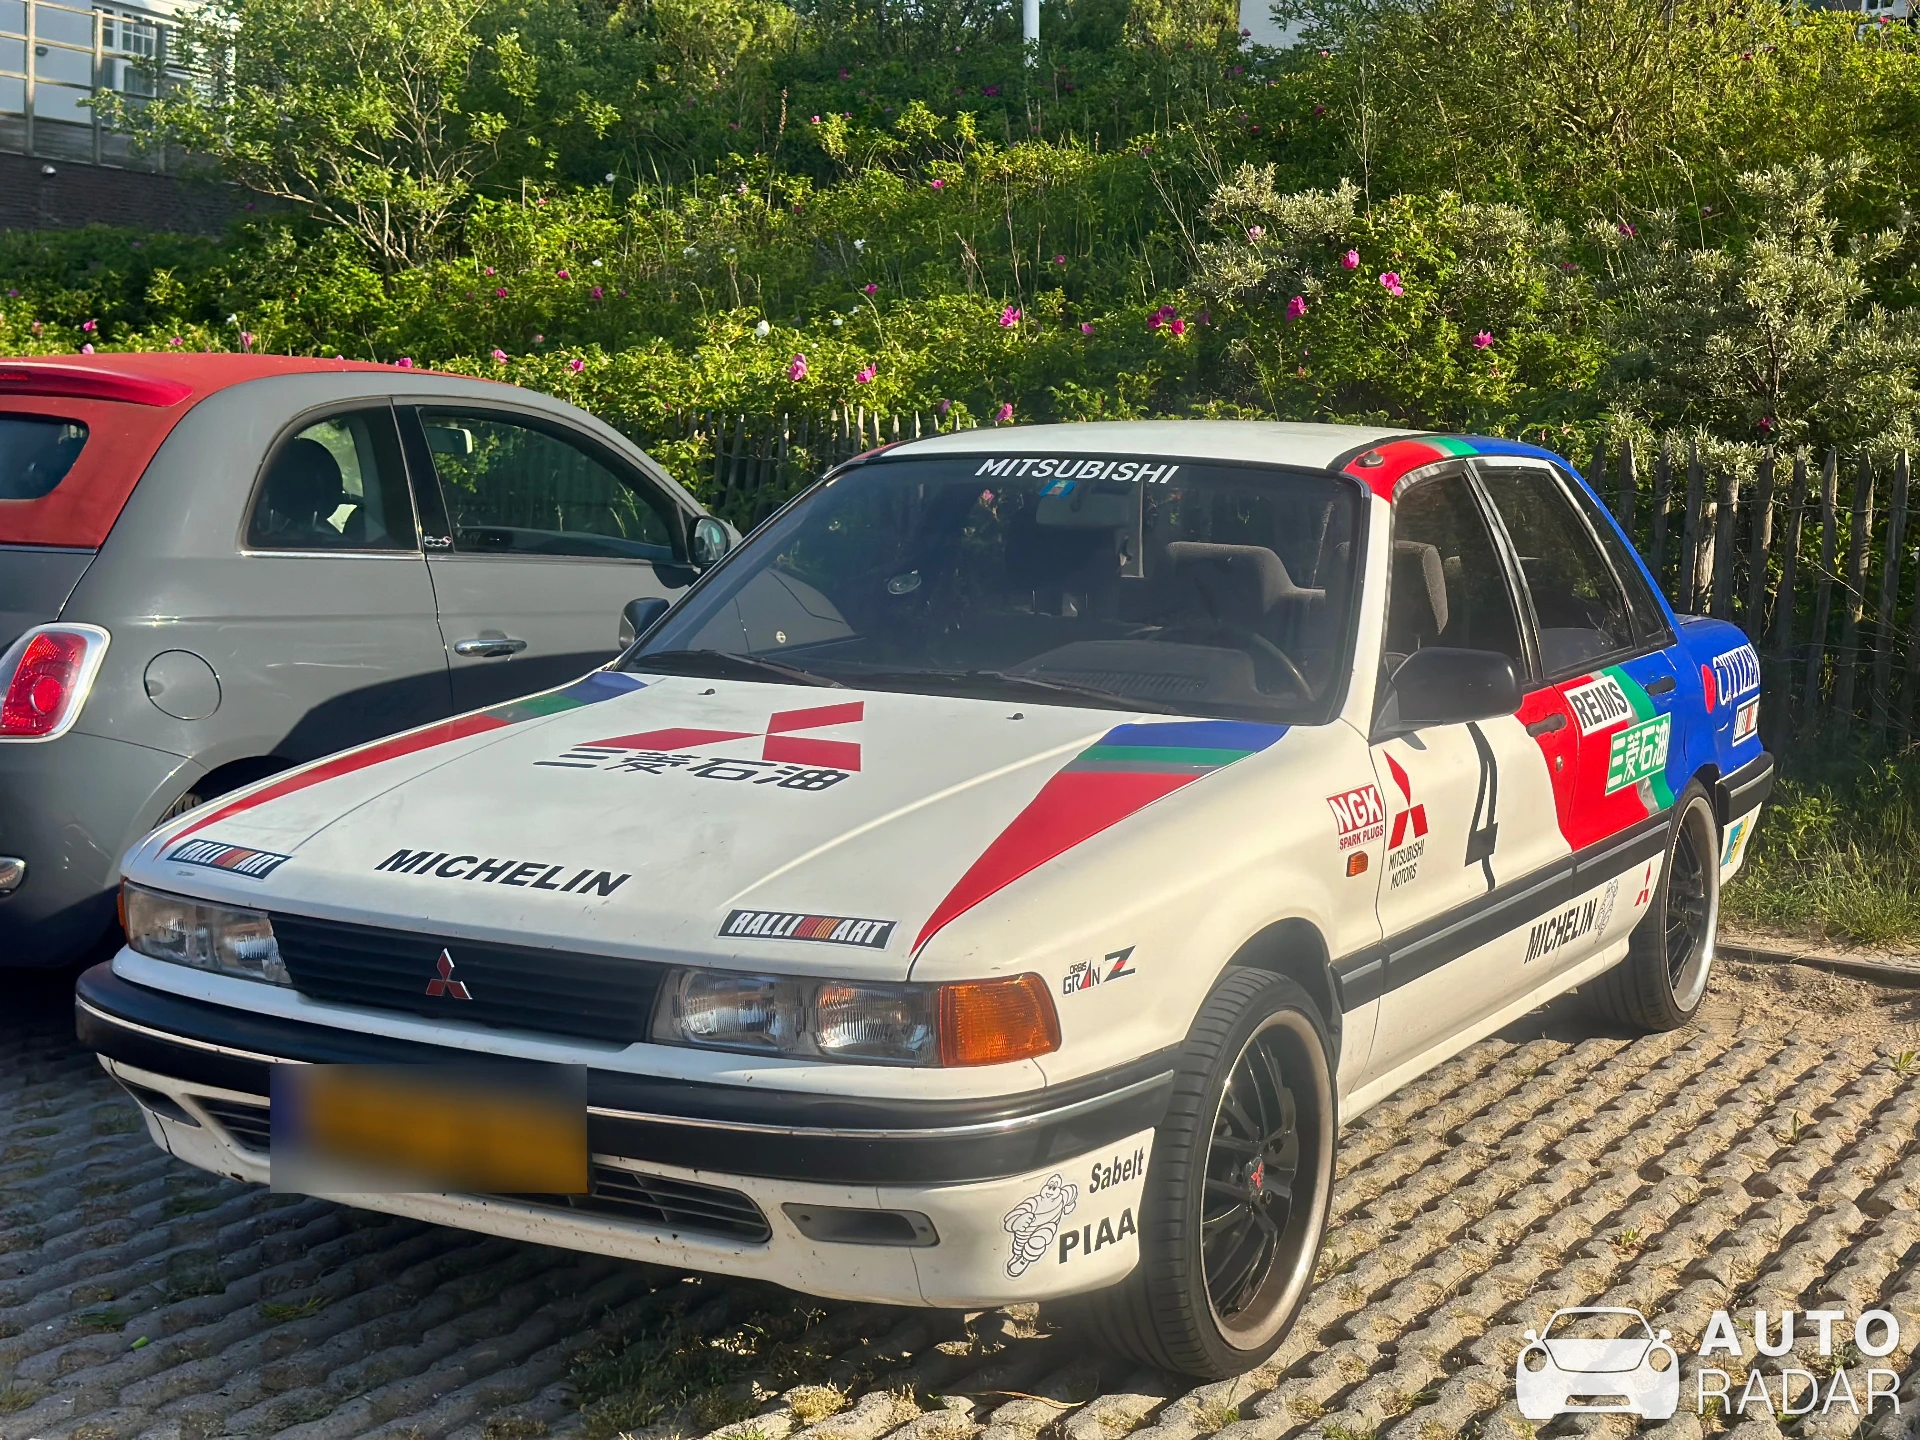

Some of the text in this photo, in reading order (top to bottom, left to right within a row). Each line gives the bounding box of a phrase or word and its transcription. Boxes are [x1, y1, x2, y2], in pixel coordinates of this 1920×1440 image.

[975, 458, 1180, 484] MITSUBISHI
[1712, 643, 1760, 706] CITIZEN
[1569, 681, 1628, 729] REIMS
[532, 747, 850, 791] 三菱石油
[1607, 719, 1669, 788] 三菱石油
[1328, 786, 1383, 835] NGK
[1464, 721, 1498, 892] 4
[1339, 824, 1384, 851] SPARK PLUGS
[1388, 838, 1425, 871] MITSUBISHI
[374, 848, 633, 897] MICHELIN
[1391, 862, 1418, 890] MOTORS
[1524, 898, 1598, 964] MICHELIN
[1063, 945, 1136, 995] GRAN Z
[1069, 961, 1087, 975] ORBIS
[1089, 1146, 1145, 1194] Sabelt
[1058, 1207, 1137, 1264] PIAA
